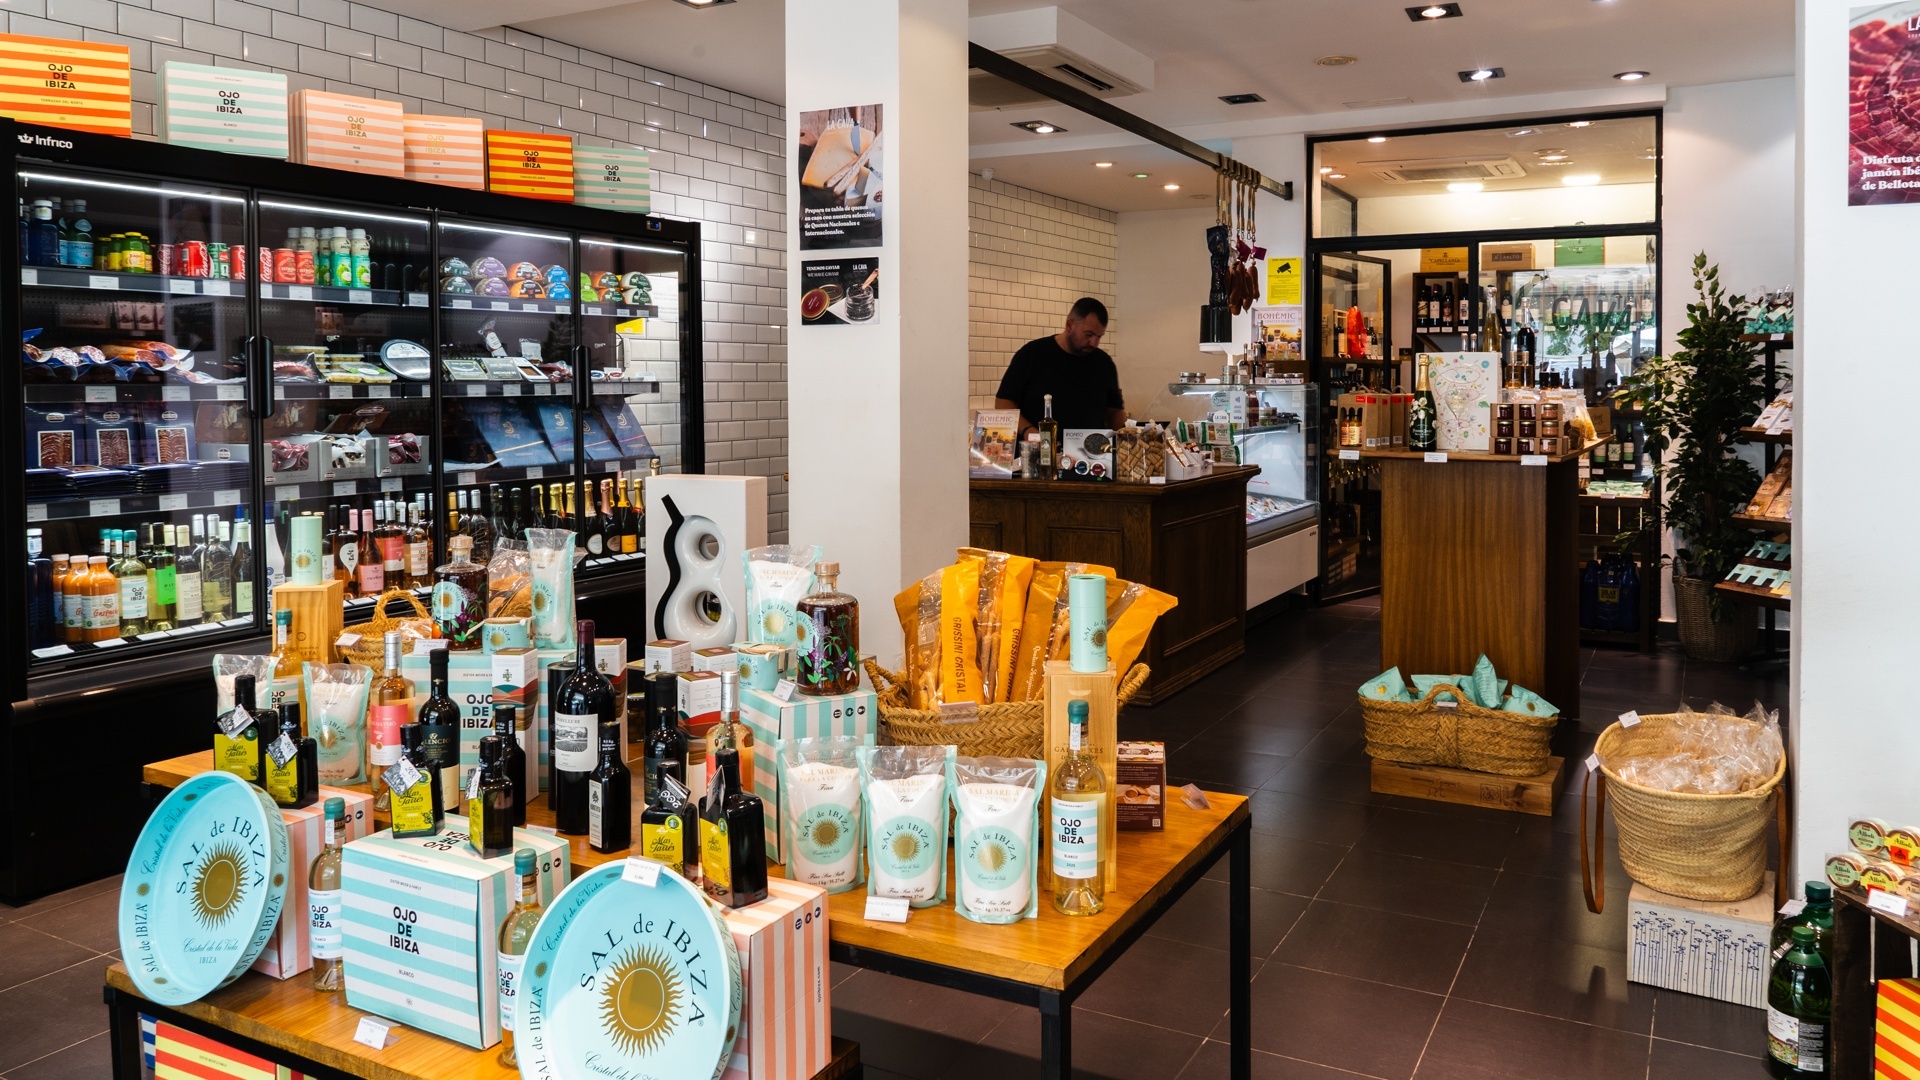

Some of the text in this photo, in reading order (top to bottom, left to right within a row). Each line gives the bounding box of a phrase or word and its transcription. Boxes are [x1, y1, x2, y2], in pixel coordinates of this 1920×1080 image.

[48, 63, 73, 72] OJO
[53, 72, 68, 80] DE
[45, 80, 76, 89] IBIZA
[219, 90, 240, 99] OJO
[223, 98, 236, 106] DE
[216, 105, 243, 114] IBIZA
[347, 115, 365, 124] OJO
[827, 118, 854, 130] LA CAVA
[345, 129, 367, 138] IBIZA
[35, 135, 73, 149] Infrico
[1863, 155, 1914, 166] Disfruta
[1861, 167, 1902, 180] jamón
[1862, 179, 1920, 191] de Bellota
[1551, 296, 1632, 335] CAVA
[979, 415, 1013, 423] BOHÊMIC
[776, 604, 794, 627] IBIZA
[1010, 628, 1021, 669] GRISSINI
[952, 616, 966, 694] GRISSINI CRISTAL
[466, 694, 493, 704] OJO
[472, 706, 489, 716] DE
[329, 720, 346, 741] IBIZA
[803, 809, 849, 838] SAL de IBIZA
[1060, 817, 1081, 828] OJO
[882, 822, 930, 850] SAL de IBIZA
[1063, 826, 1077, 836] DE
[140, 806, 186, 876] Cristal de la Vida
[439, 837, 460, 845] DE
[1058, 834, 1085, 845] IBIZA
[423, 841, 453, 851] OJO
[969, 840, 981, 859] SAL
[994, 833, 1017, 861] IBIZA
[176, 815, 266, 895] SAL de IBIZA
[311, 905, 329, 914] OJO
[393, 906, 418, 924] OJO
[314, 913, 325, 921] DE
[541, 917, 570, 953] Cristal
[568, 905, 580, 918] de
[578, 881, 604, 899] Vida
[311, 919, 332, 929] IBIZA
[397, 922, 413, 938] DE
[235, 897, 281, 971] SAL de IBIZA
[135, 904, 159, 979] SAL de IBIZA
[183, 936, 239, 953] Cristal de la Vida
[389, 935, 420, 955] IBIZA
[199, 956, 217, 964] IBIZA
[399, 969, 415, 979] BLANCO
[580, 912, 709, 1027] SAL de IBIZA
[500, 978, 511, 988] DE
[529, 990, 543, 1050] de IBIZA
[584, 1050, 617, 1080] Cristal
